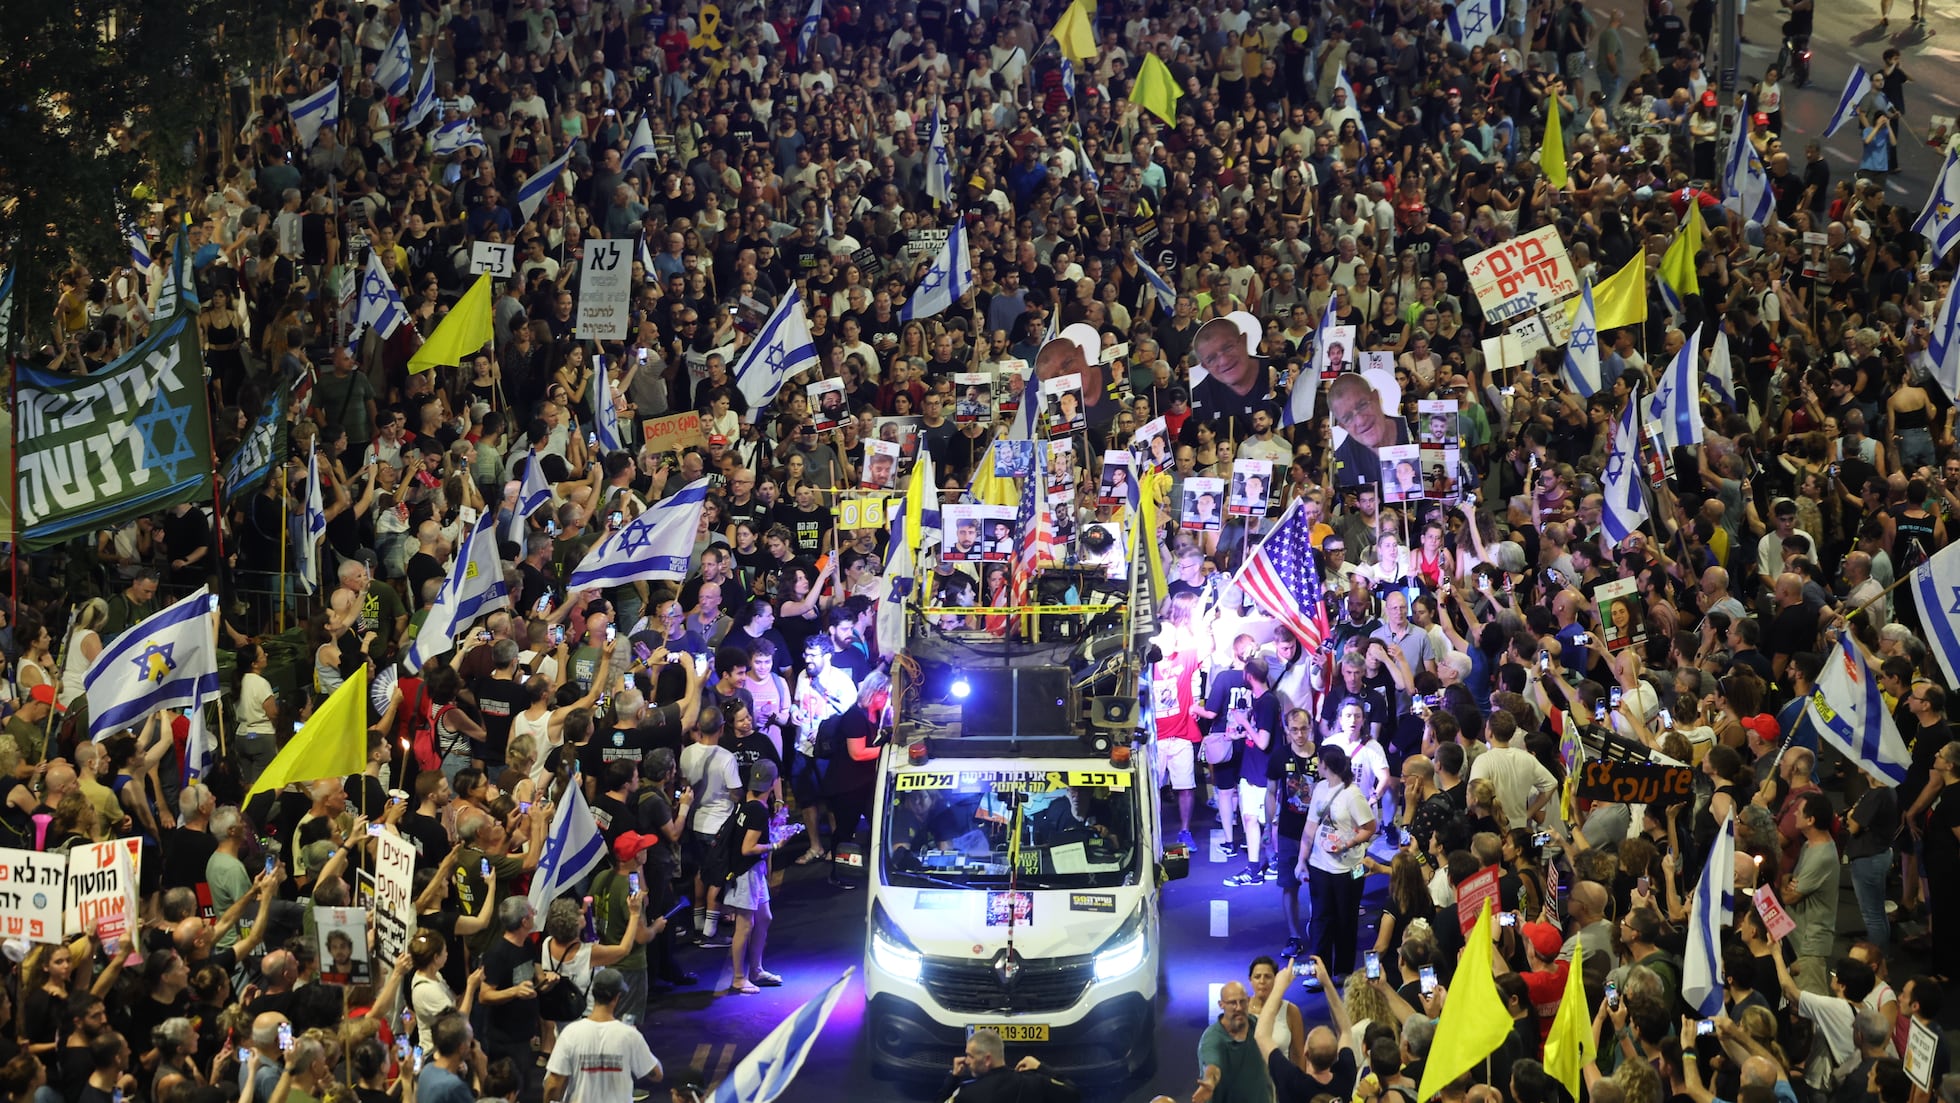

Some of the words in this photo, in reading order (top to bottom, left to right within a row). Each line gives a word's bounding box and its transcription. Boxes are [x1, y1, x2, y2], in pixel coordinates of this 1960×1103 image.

[488, 246, 507, 263] די
[590, 241, 620, 270] לא
[1485, 237, 1547, 278] מים
[476, 261, 504, 273] כבר
[1496, 257, 1559, 299] קרים
[1552, 279, 1574, 297] קולה
[583, 304, 614, 318] להרעבה
[18, 419, 150, 527] לנשק
[901, 773, 955, 788] מלווה
[1029, 771, 1046, 782] אני
[1029, 782, 1046, 793] מה
[1081, 772, 1119, 785] רכב
[91, 841, 117, 869] עד
[383, 839, 411, 876] רוצים
[14, 856, 36, 884] לא
[42, 866, 63, 887] זה
[70, 868, 118, 909] החטוף
[378, 873, 408, 913] אותם
